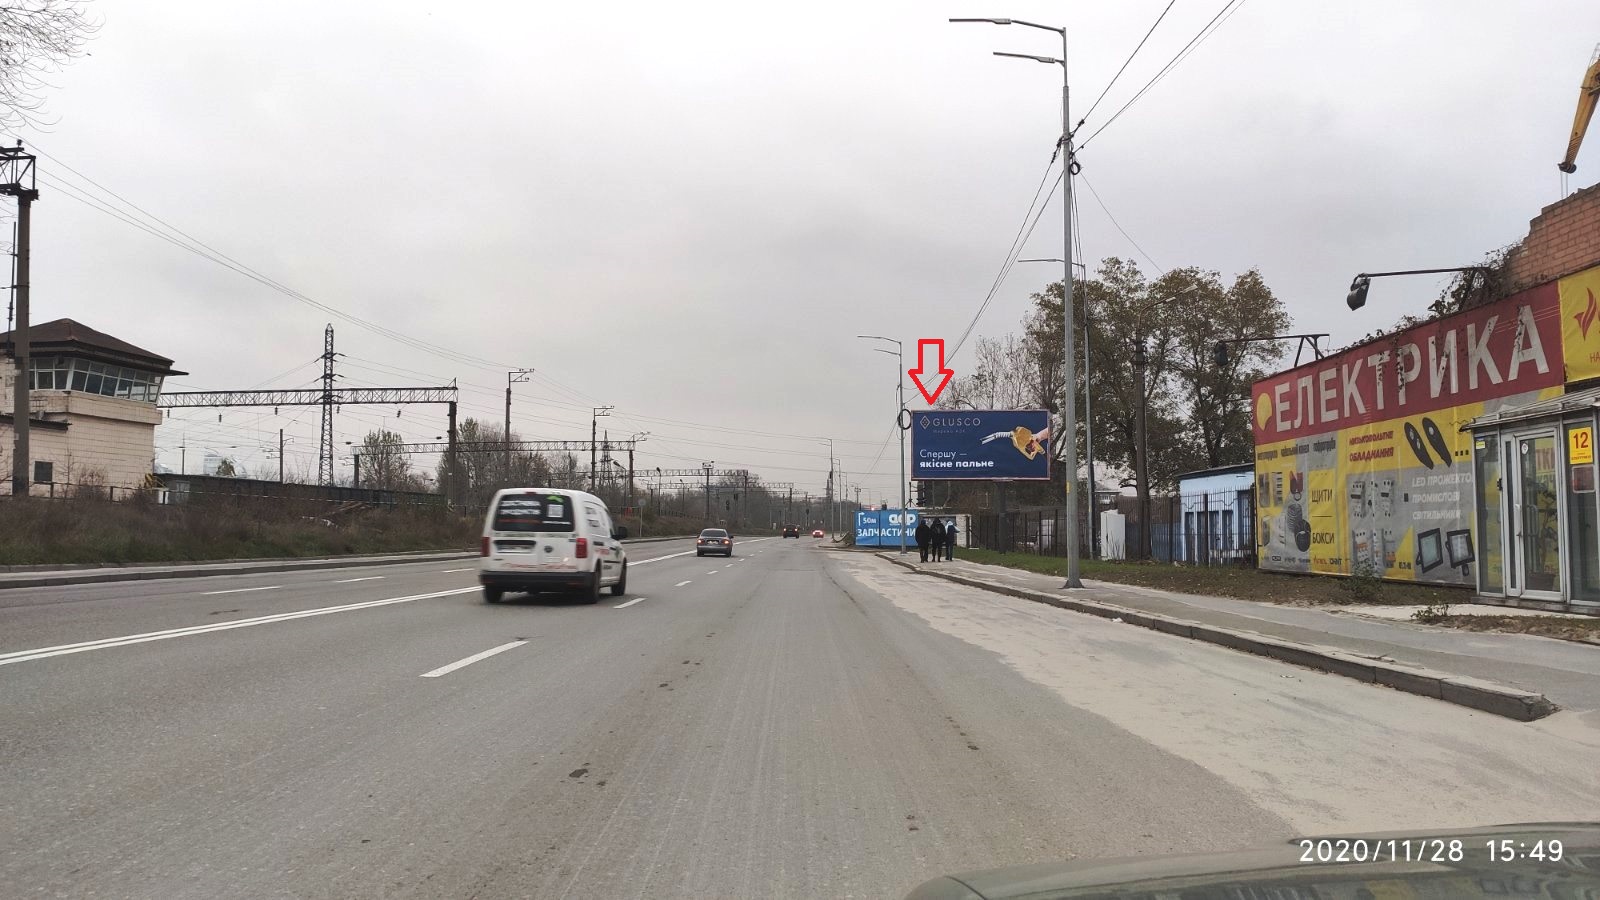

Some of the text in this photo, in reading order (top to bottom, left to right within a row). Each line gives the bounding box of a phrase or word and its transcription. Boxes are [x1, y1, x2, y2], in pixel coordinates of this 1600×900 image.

[1274, 305, 1549, 432] ЕЛЕКТРИКА
[933, 418, 980, 426] GLUSCO
[1573, 432, 1589, 449] 12
[920, 449, 956, 460] Спершу
[920, 459, 953, 468] якісне
[1412, 477, 1426, 488] LED
[1312, 489, 1333, 504] ЩИТИ
[857, 528, 916, 537] ЗАПЧАСТИНИ
[1312, 532, 1335, 544] БОКСИ
